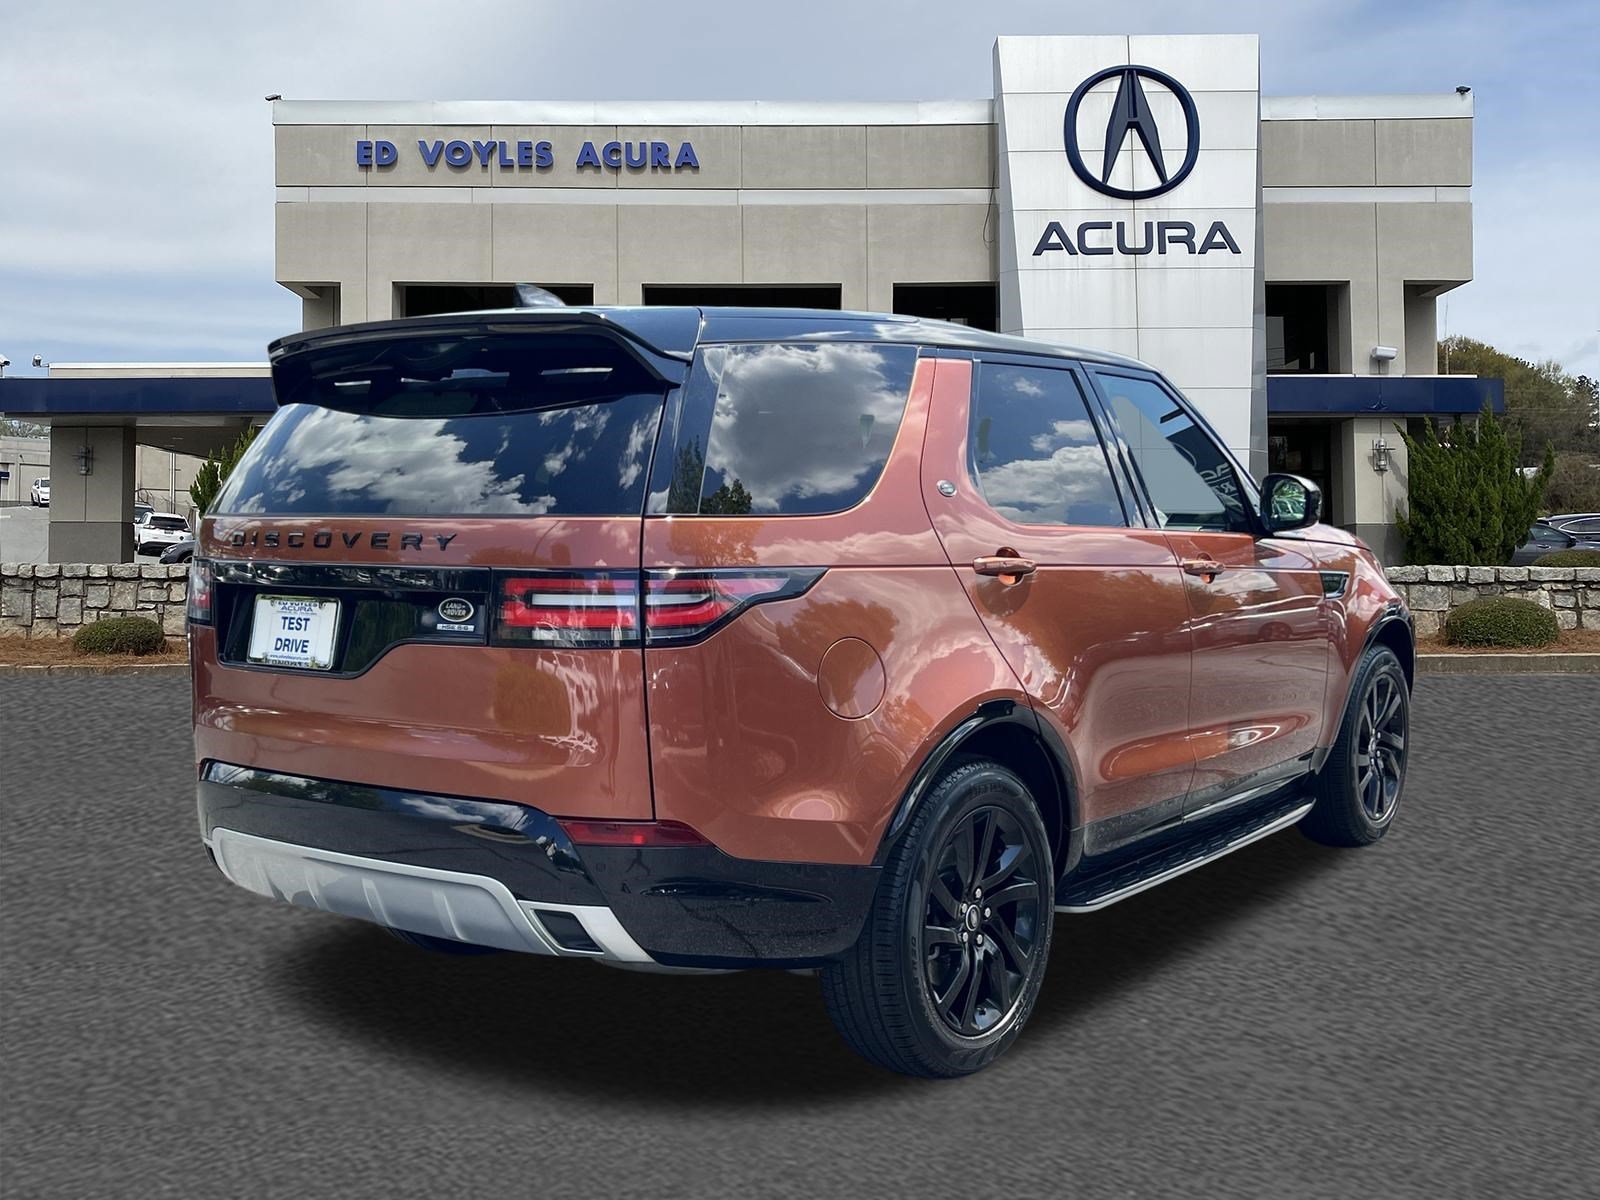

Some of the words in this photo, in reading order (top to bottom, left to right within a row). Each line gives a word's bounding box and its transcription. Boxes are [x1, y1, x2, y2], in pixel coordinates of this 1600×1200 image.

[356, 140, 397, 167] ED
[418, 140, 554, 168] VOYLES
[576, 140, 700, 168] ACURA
[1032, 221, 1241, 256] ACURA
[232, 529, 457, 551] DISCOVERY
[281, 616, 310, 631] TEST
[274, 637, 309, 653] DRIVE
